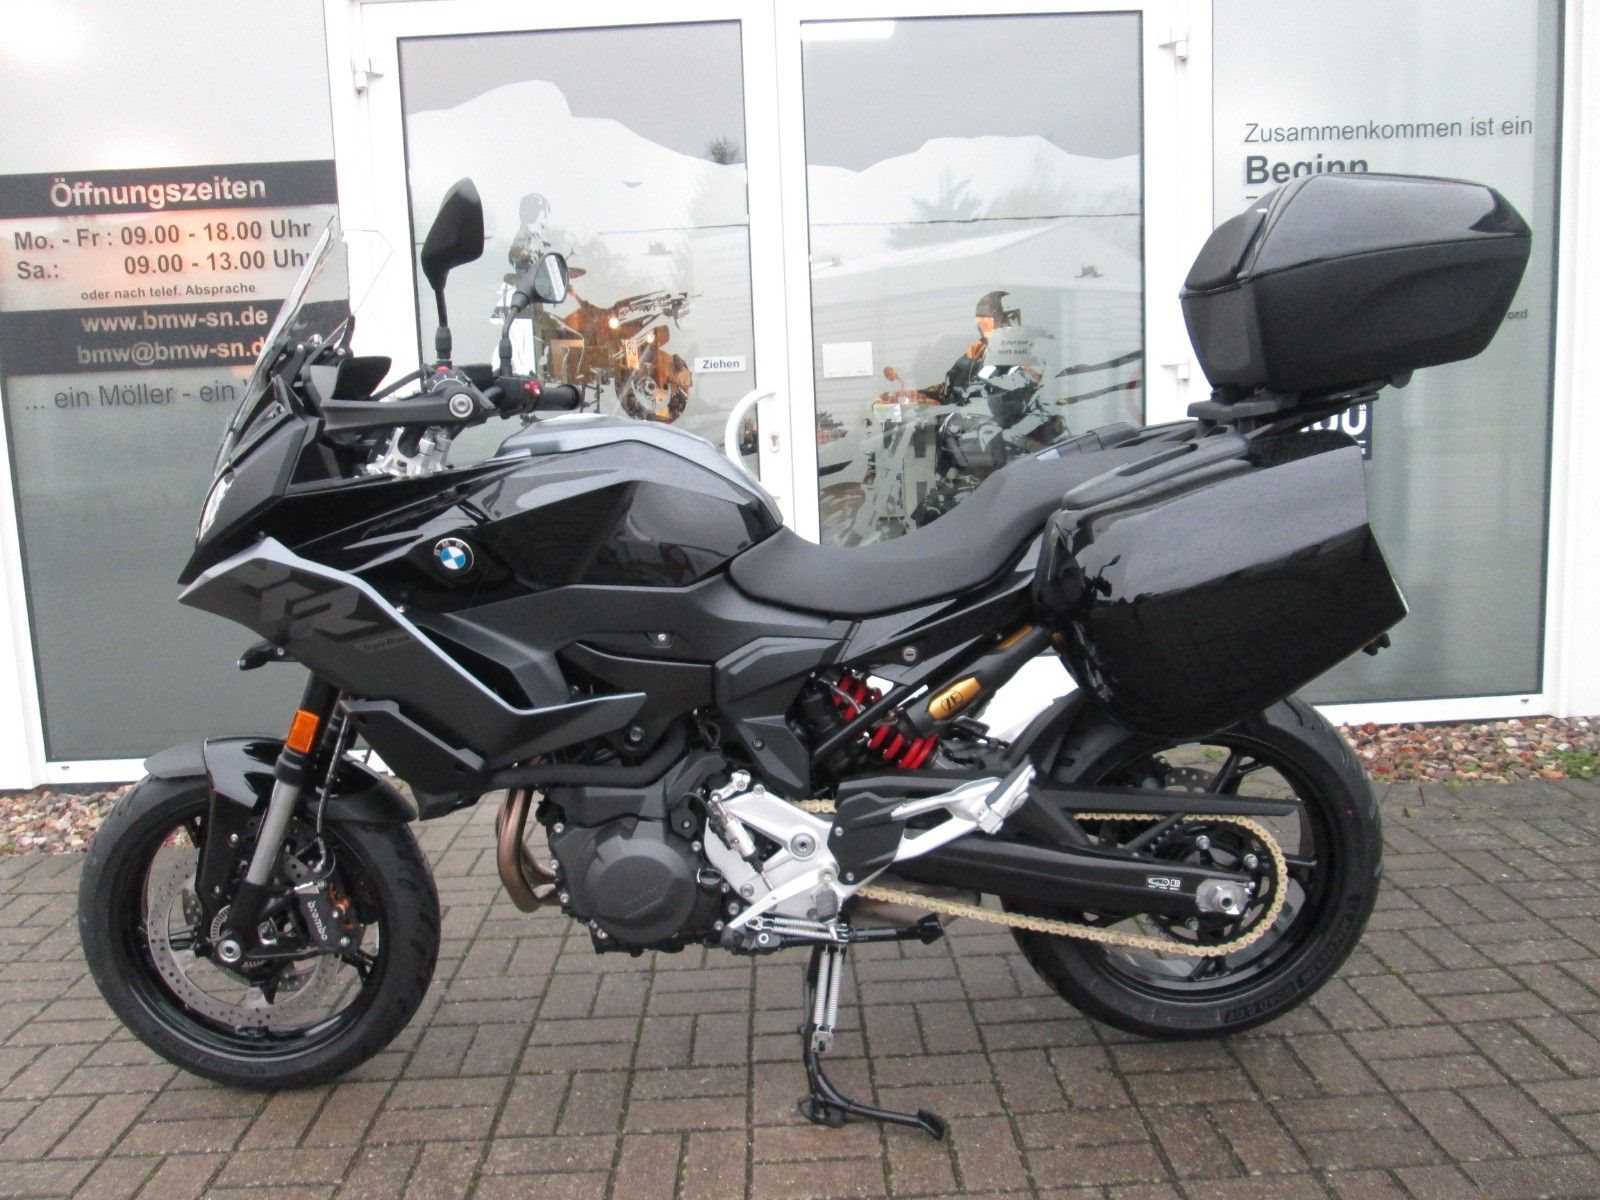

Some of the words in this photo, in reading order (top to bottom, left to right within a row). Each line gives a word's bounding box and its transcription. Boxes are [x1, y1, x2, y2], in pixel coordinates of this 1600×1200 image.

[1244, 119, 1462, 143] Zusammenkommen
[1470, 117, 1495, 137] ist
[1501, 116, 1533, 136] ein
[50, 176, 267, 210] Öffnungszeiten
[14, 231, 54, 251] Mo.
[120, 224, 180, 247] 09.00
[203, 220, 263, 243] 18.00
[270, 219, 312, 240] Uhr
[16, 260, 59, 281] Sa.:
[124, 253, 183, 275] 09.00
[206, 250, 265, 272] 13.00
[81, 288, 110, 301] oder
[115, 286, 145, 299] nach
[150, 285, 182, 298] telef.
[186, 283, 256, 297] Absprache
[81, 306, 268, 333] www.bmw-sn.de
[1507, 308, 1529, 320] ord
[77, 336, 266, 366] bmw@bmw-sn.d
[702, 359, 740, 369] Ziehen
[54, 386, 90, 409] ein
[98, 383, 175, 407] Möller
[200, 379, 235, 402] ein
[307, 900, 328, 941] brembo
